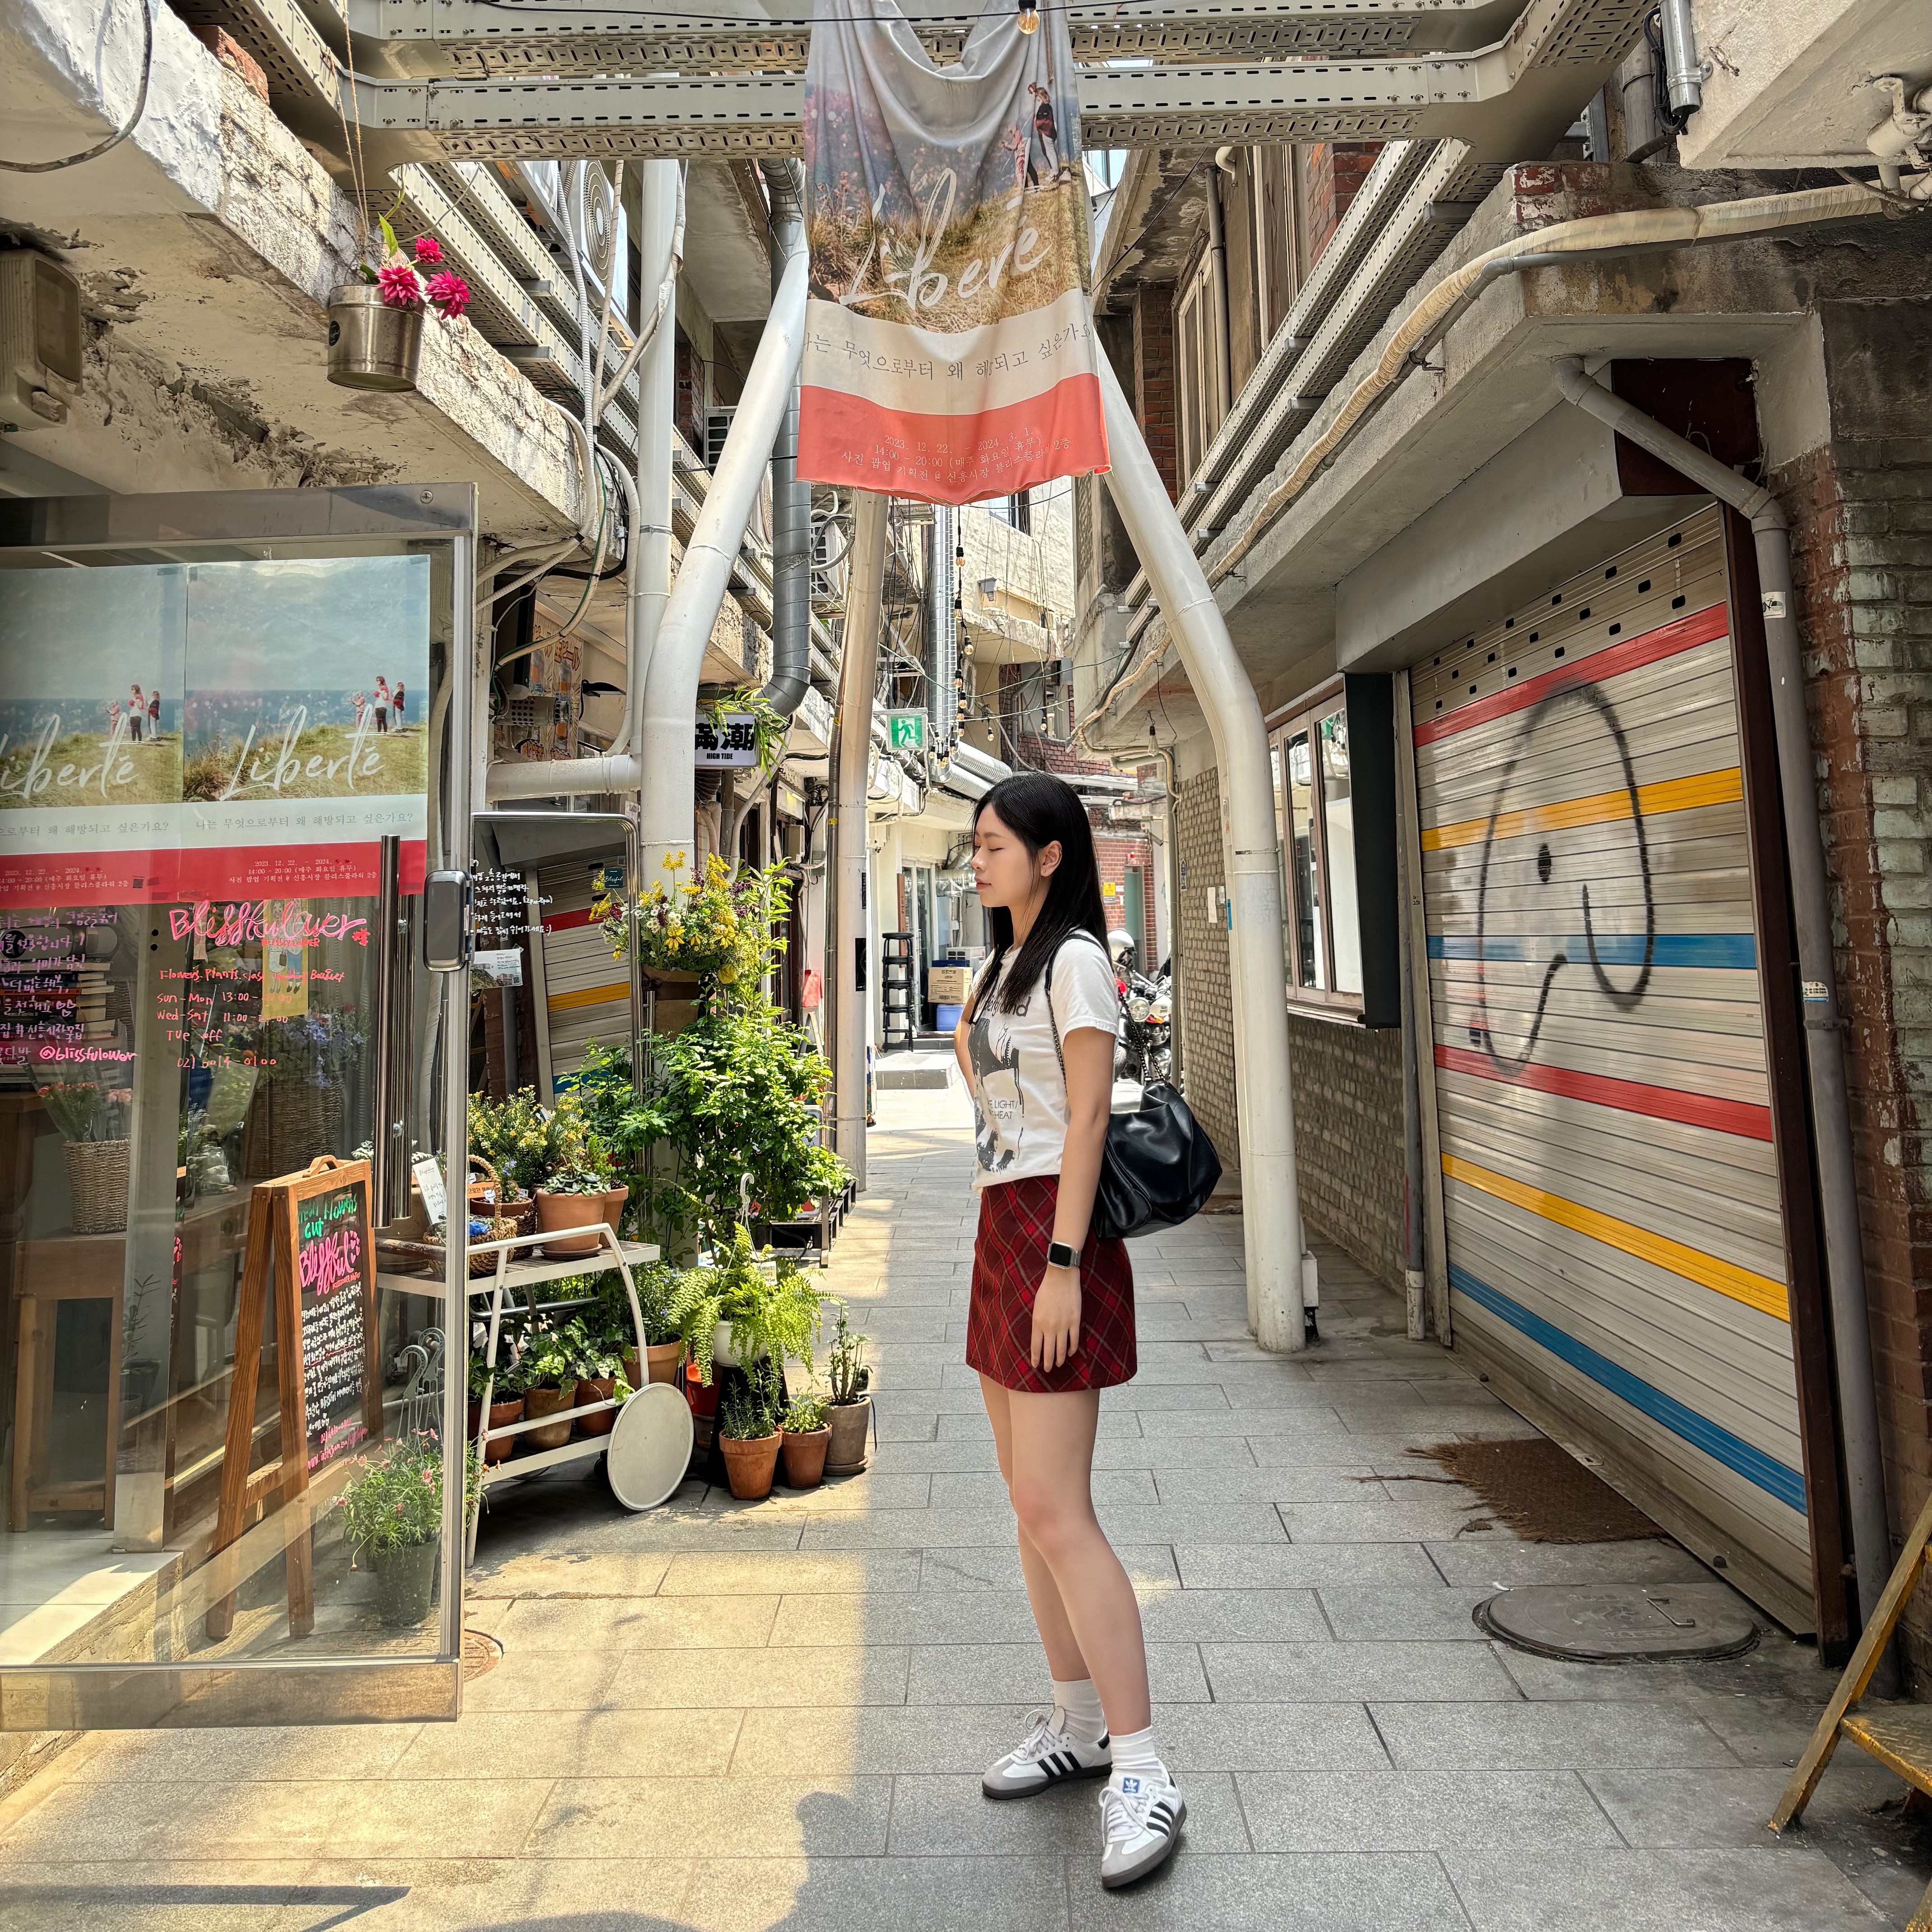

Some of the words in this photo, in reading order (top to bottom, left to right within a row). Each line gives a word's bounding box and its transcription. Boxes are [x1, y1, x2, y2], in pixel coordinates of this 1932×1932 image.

[842, 340, 933, 381] 무엇으로부터
[947, 361, 963, 381] 왜
[976, 351, 1028, 379] 해되고
[841, 451, 863, 465] 사진
[871, 457, 891, 472] 팝업
[897, 465, 929, 481] 기획전
[947, 468, 989, 483] 신흥시장
[1053, 437, 1071, 450] 2층
[875, 445, 899, 461] 14:00
[915, 455, 942, 467] 20:00
[949, 455, 974, 469] (매주
[980, 447, 1009, 465] 화요일
[1015, 436, 1041, 452] 휴무)
[885, 435, 908, 450] 2023.
[917, 442, 930, 452] 12.
[937, 444, 952, 454] 22.
[978, 437, 1003, 451] 2024.
[220, 703, 392, 801] Liberté
[48, 826, 58, 835] 왜
[65, 824, 110, 835] 해방되고
[118, 822, 169, 833] 싶은가요?
[196, 819, 216, 829] 나는
[225, 817, 289, 828] 무엇으로부터
[296, 816, 306, 826] 왜
[313, 814, 356, 826] 해방되고
[364, 812, 414, 824] 싶은가요?
